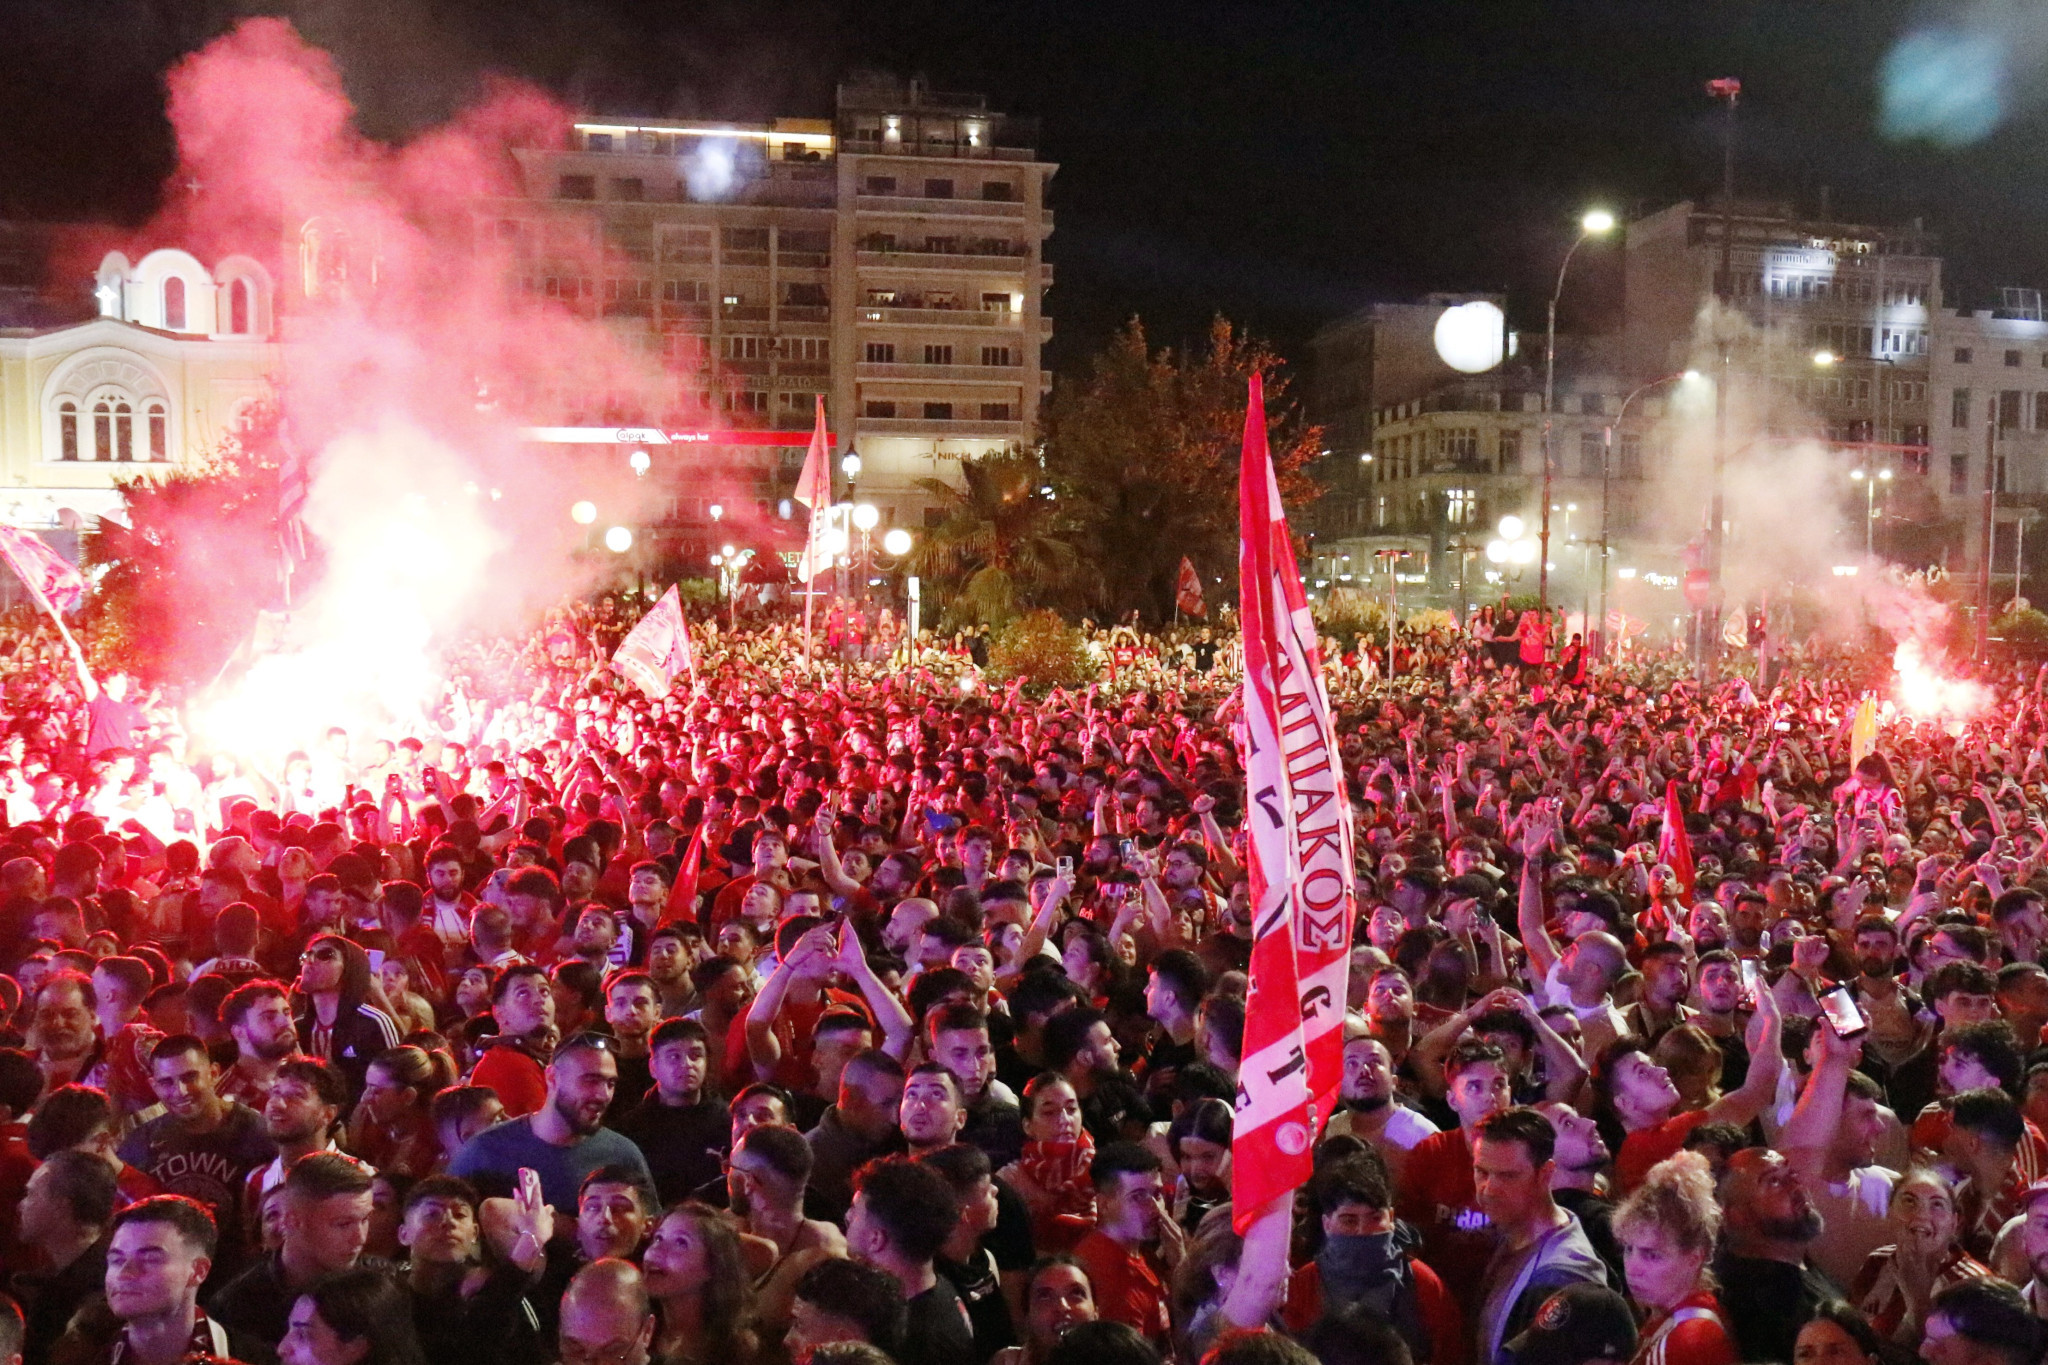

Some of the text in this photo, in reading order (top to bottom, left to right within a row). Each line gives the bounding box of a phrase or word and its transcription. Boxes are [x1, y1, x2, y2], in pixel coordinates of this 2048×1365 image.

[671, 432, 709, 443] always hot
[1278, 642, 1344, 947] ΜΠΙΑΚΟΣ
[149, 1152, 237, 1183] TOWN
